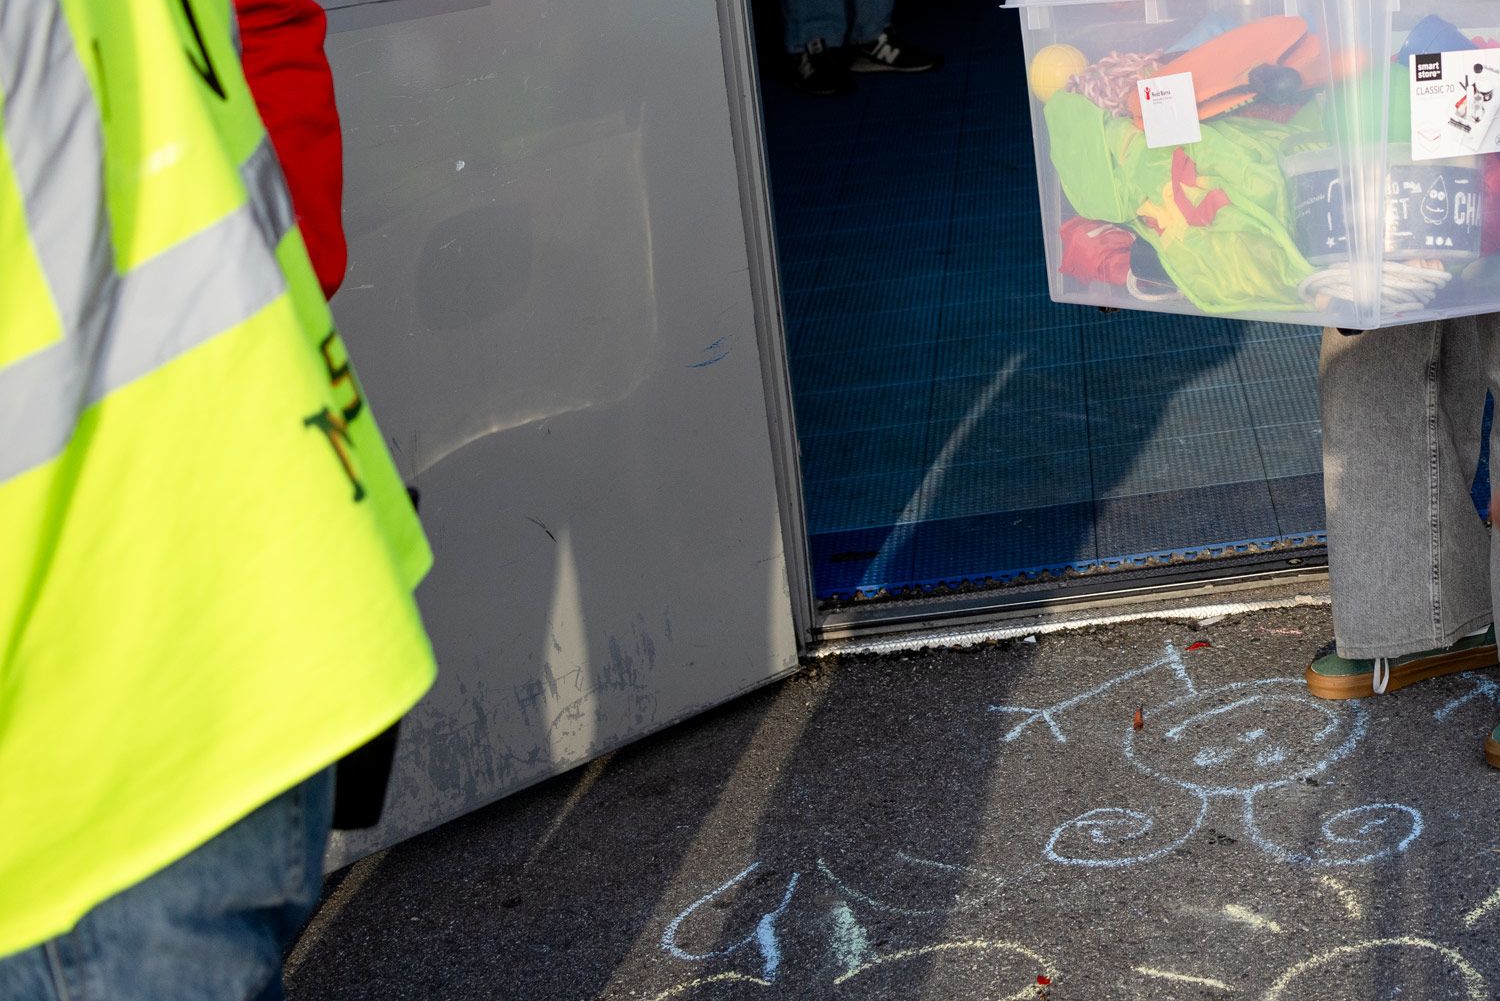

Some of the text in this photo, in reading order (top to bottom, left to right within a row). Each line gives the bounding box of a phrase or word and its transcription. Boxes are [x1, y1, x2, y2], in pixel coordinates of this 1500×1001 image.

[1417, 61, 1440, 72] smart
[1416, 84, 1455, 96] CLASSIC 70
